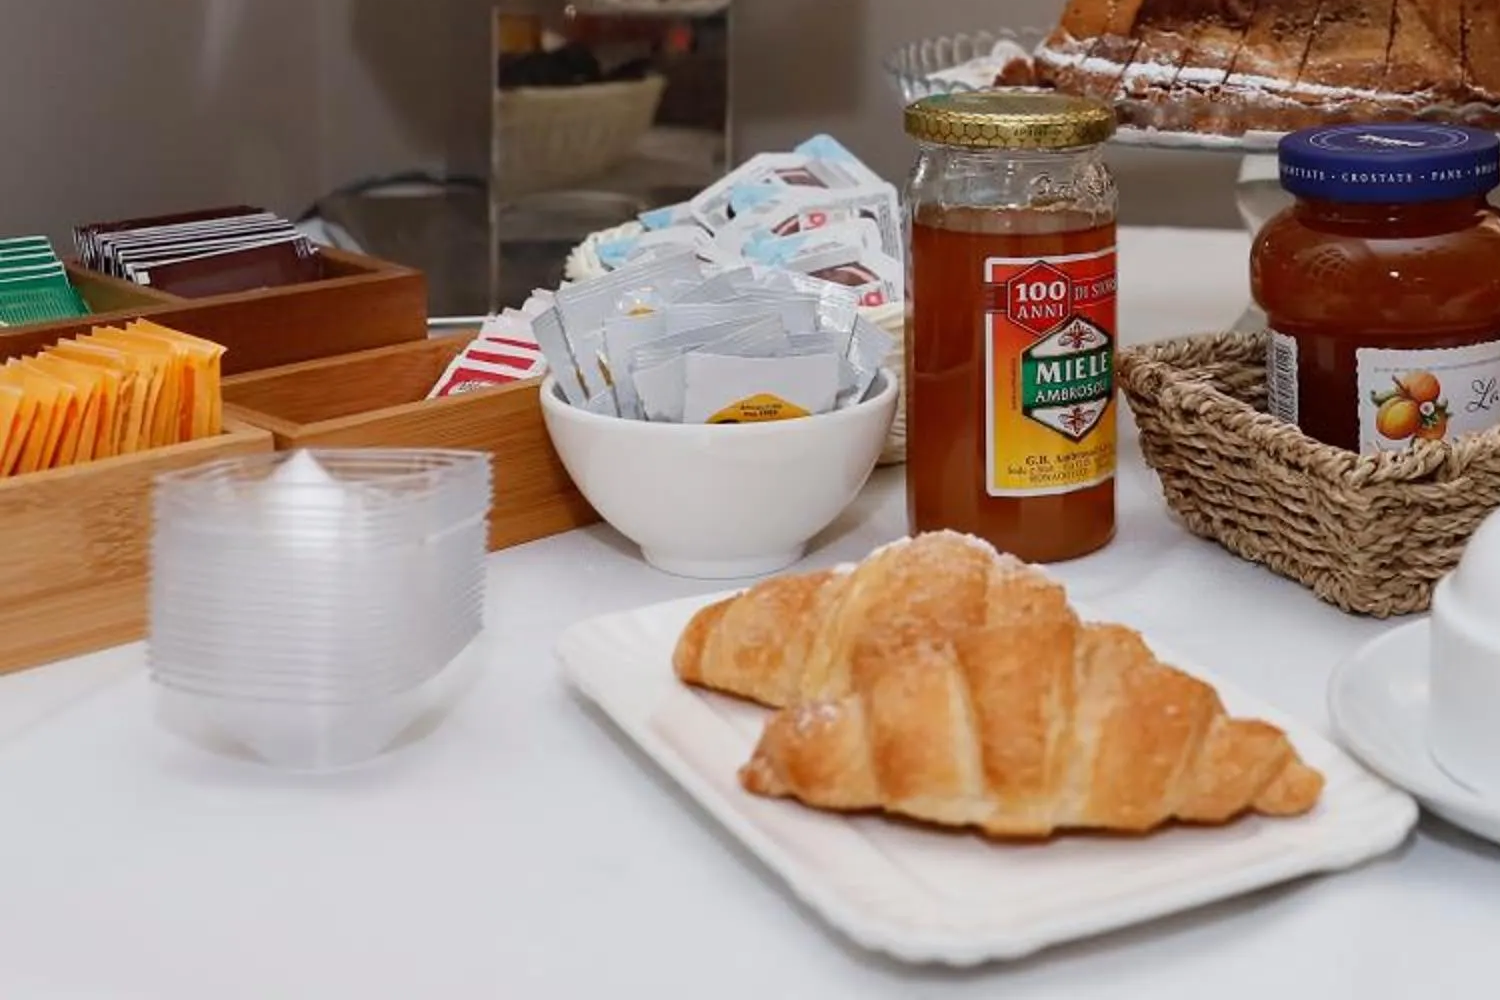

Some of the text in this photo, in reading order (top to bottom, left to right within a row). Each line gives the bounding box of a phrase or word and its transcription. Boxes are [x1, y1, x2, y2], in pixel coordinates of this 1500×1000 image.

[1341, 172, 1413, 184] CROSTATE
[1015, 281, 1067, 302] 100
[1073, 284, 1089, 301] DI
[1017, 303, 1064, 320] ANNI
[1035, 351, 1109, 385] MIELE
[1465, 376, 1500, 413] La
